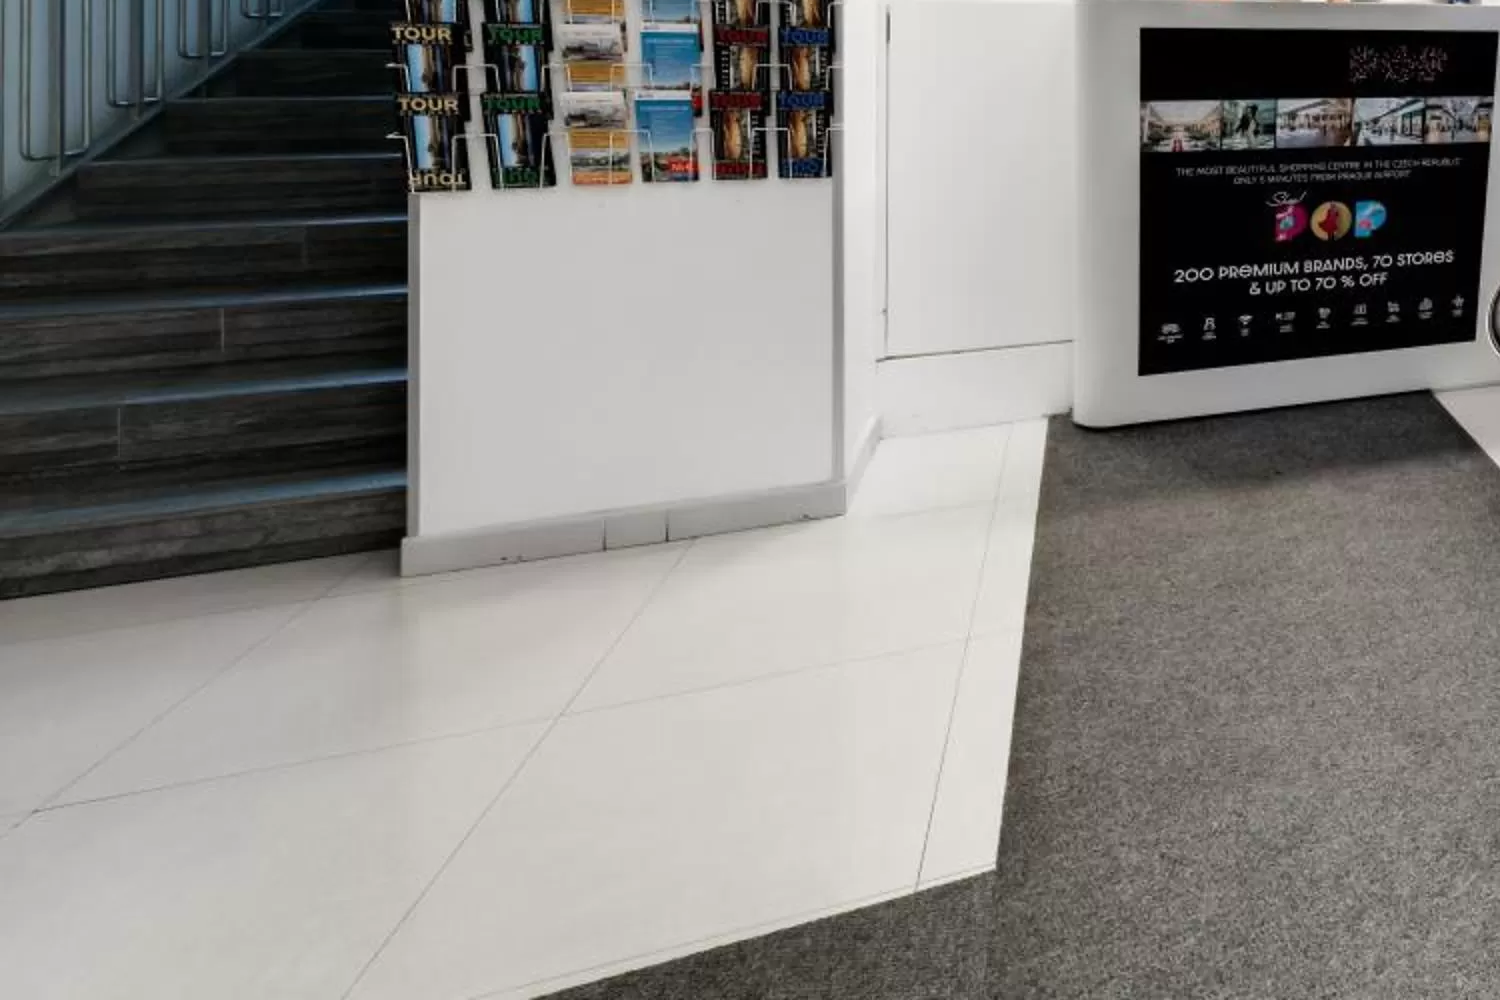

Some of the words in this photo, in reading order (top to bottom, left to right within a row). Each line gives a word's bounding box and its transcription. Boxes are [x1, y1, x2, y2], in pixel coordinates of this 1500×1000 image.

[391, 27, 451, 42] TOUR
[398, 97, 458, 111] TOUR
[1174, 266, 1214, 283] 200
[1303, 256, 1368, 273] BRANDS,
[1373, 254, 1393, 268] 70
[1396, 249, 1455, 267] STORES
[1265, 279, 1287, 295] UP
[1290, 278, 1311, 293] TO
[1315, 276, 1337, 291] 70
[1341, 275, 1355, 288] %
[1359, 271, 1388, 287] OFF
